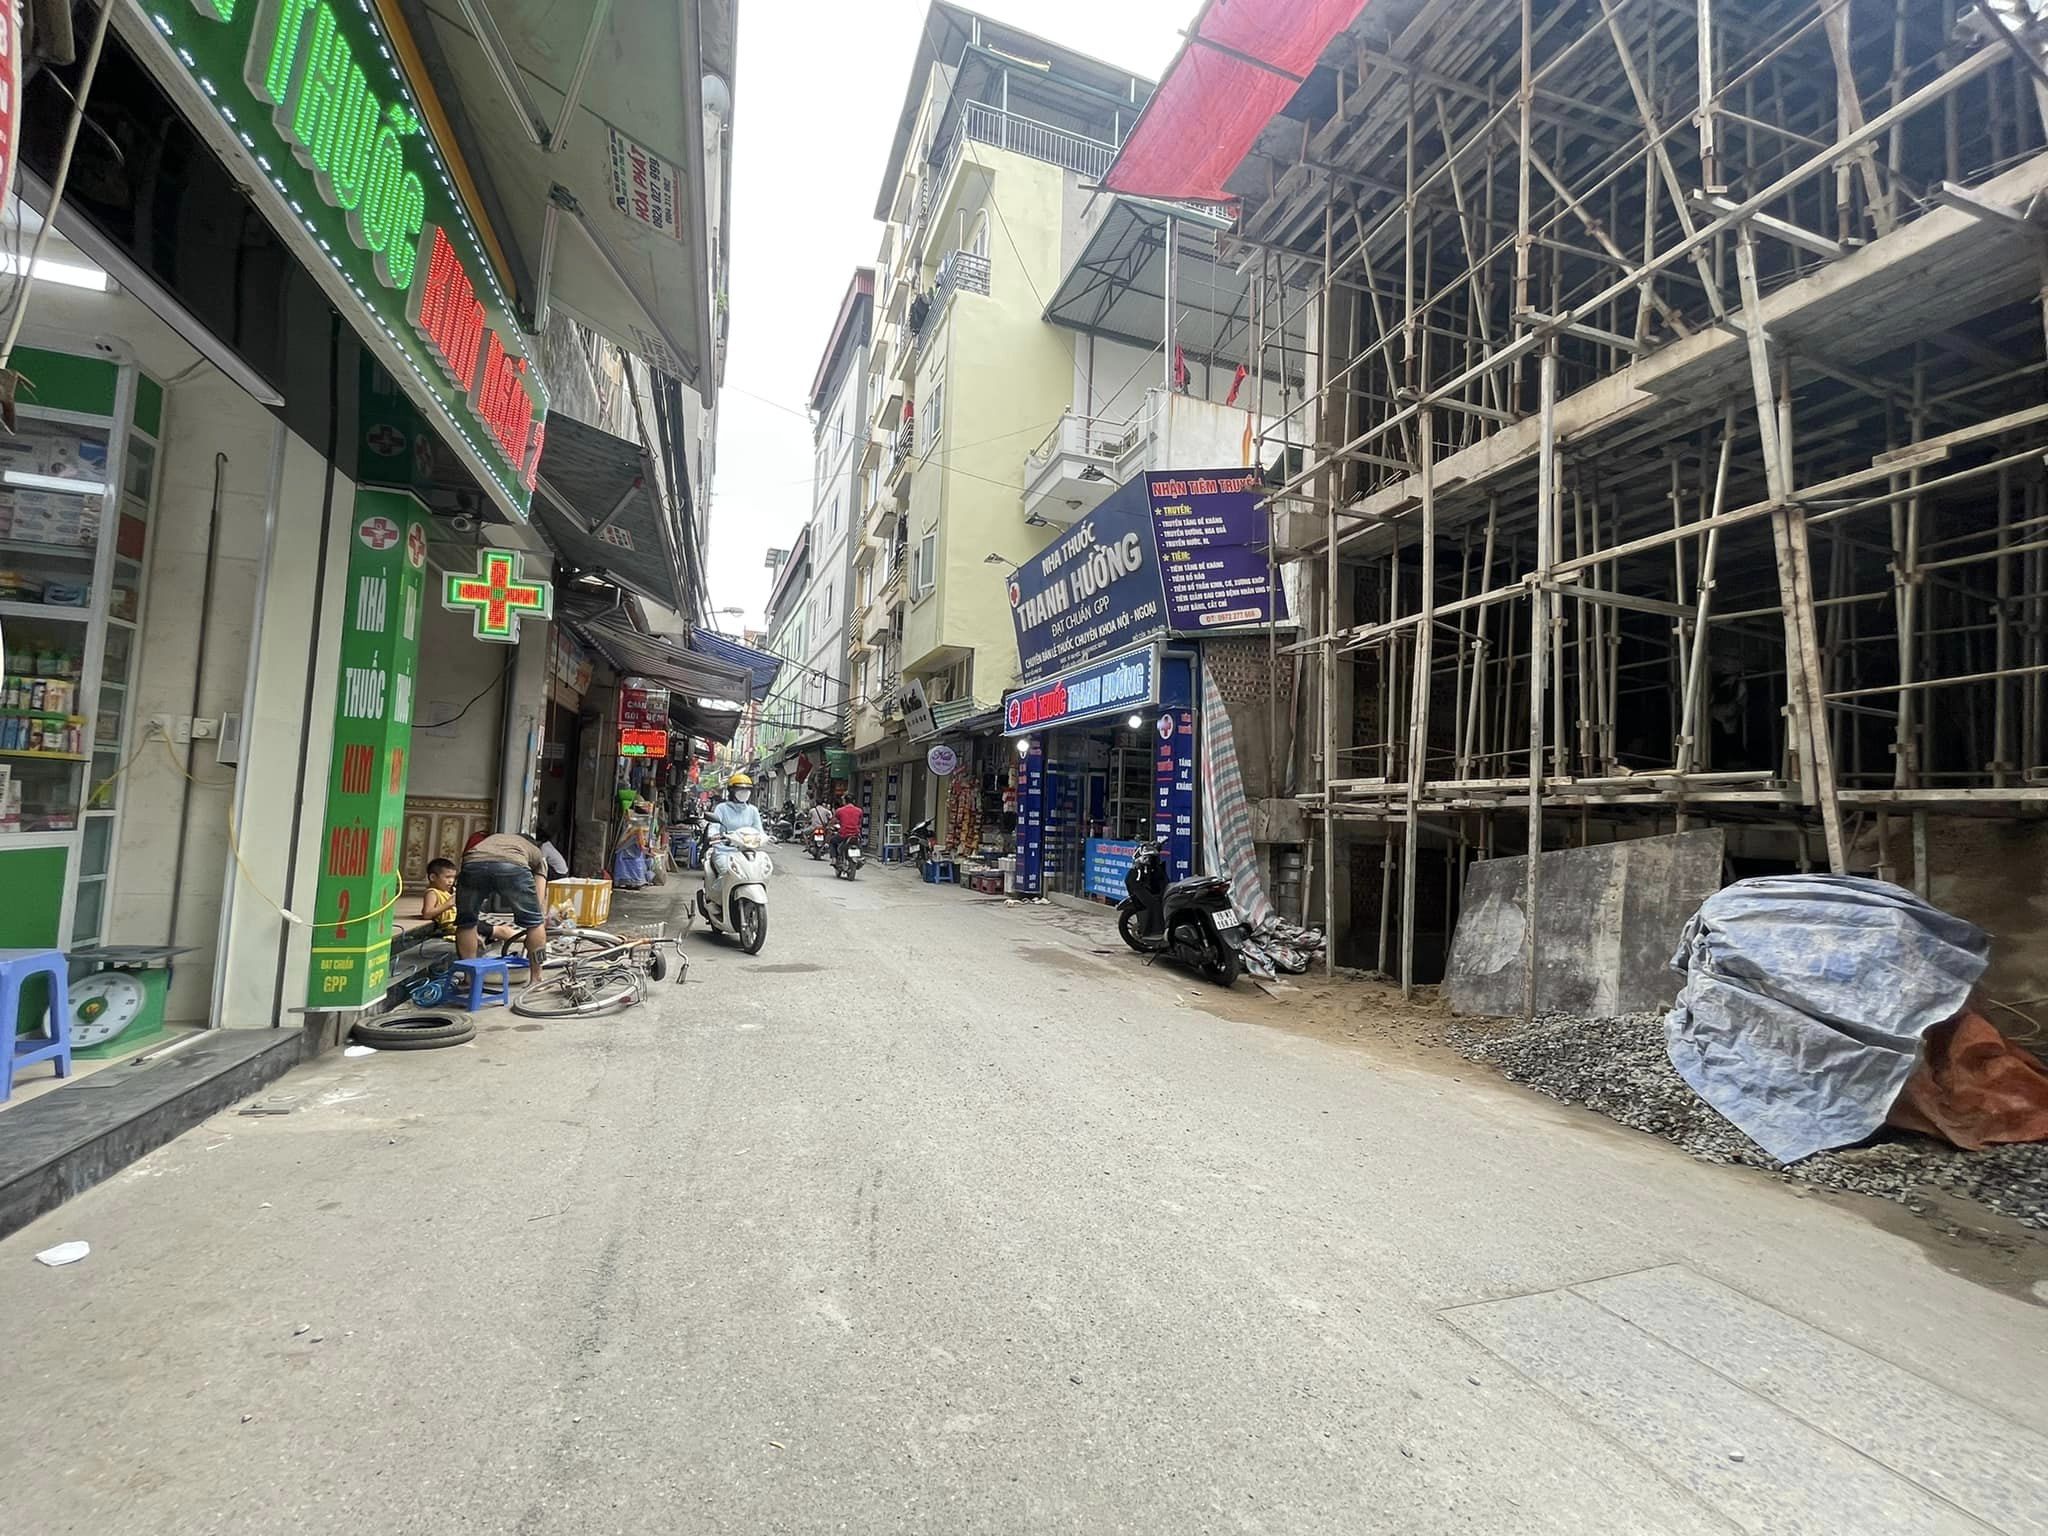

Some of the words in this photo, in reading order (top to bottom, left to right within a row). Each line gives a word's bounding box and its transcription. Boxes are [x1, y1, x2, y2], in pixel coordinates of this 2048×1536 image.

[627, 143, 648, 190] PHÁT
[649, 157, 660, 181] 999
[631, 190, 650, 223] HÒA
[1152, 478, 1188, 499] NHẬN
[1188, 477, 1218, 495] TIÊM
[1061, 520, 1096, 562] THUỐC
[1017, 579, 1070, 632] THANH
[1070, 532, 1142, 603] HƯỜNG
[1051, 620, 1064, 637] ĐẠT
[1094, 595, 1110, 615] GPP
[1098, 620, 1117, 638] KHOA
[1117, 611, 1130, 630] NỘI
[1134, 600, 1157, 622] NGOẠI
[343, 650, 386, 720] THUỐC
[1067, 676, 1101, 713] THANH
[1102, 662, 1144, 703] HƯỜNG
[341, 743, 375, 794] KIM
[328, 816, 370, 877] NGÂN
[336, 889, 350, 939] 2
[323, 975, 348, 993] GPP
